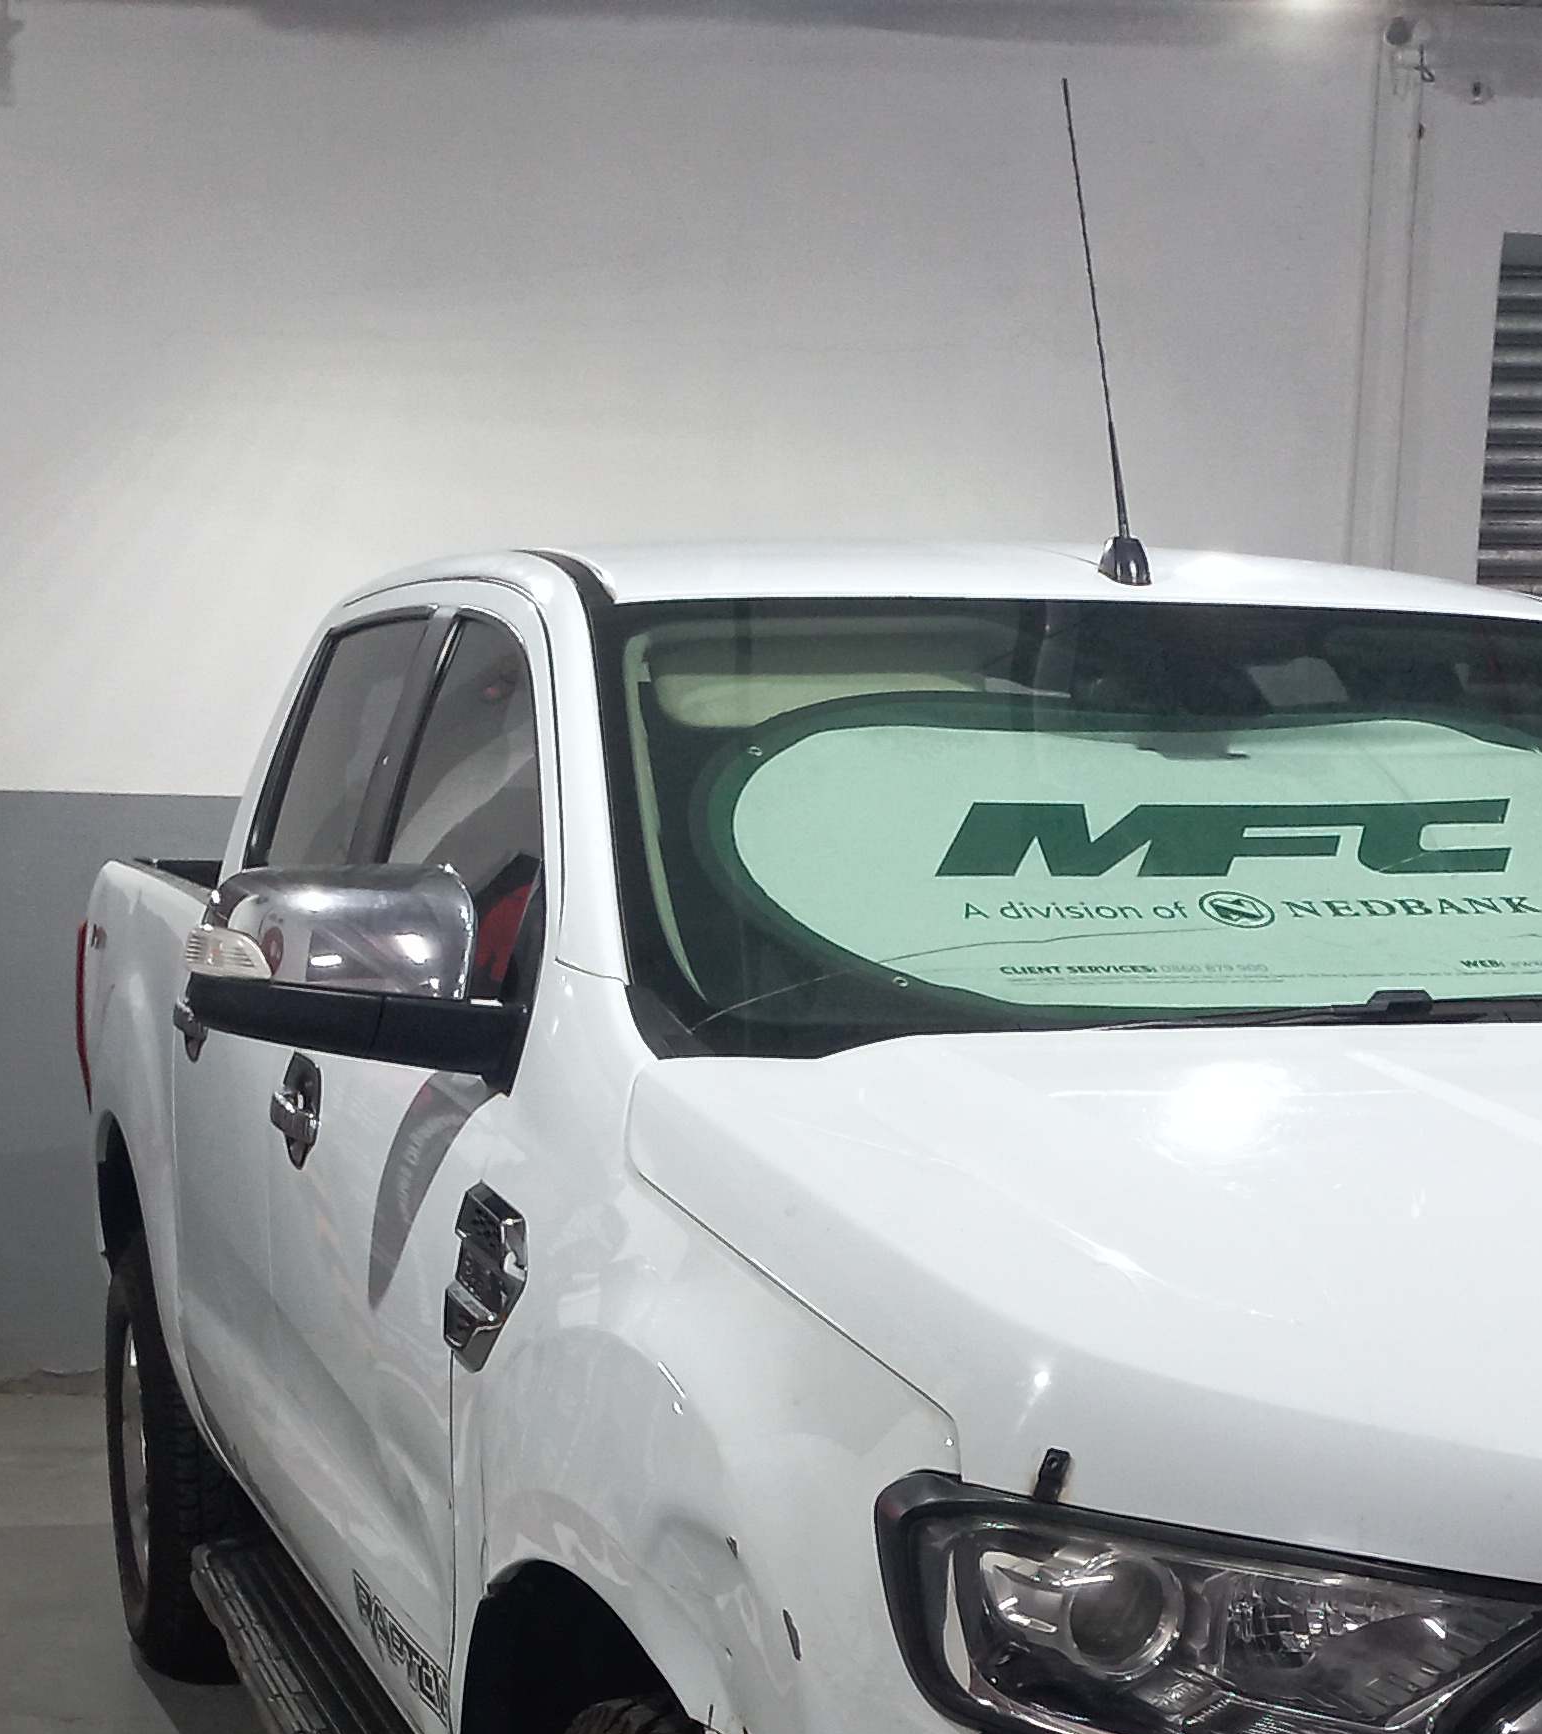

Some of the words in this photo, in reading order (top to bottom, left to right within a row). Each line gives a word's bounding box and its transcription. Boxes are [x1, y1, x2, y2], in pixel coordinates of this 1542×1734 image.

[935, 798, 1512, 877] MFC
[963, 902, 990, 919] A
[999, 900, 1143, 920] division
[1152, 900, 1189, 920] of
[1281, 896, 1542, 918] NEDBANK
[999, 965, 1061, 976] CLIENT
[1066, 964, 1158, 975] SERVICES:
[1460, 958, 1505, 970] WEB:
